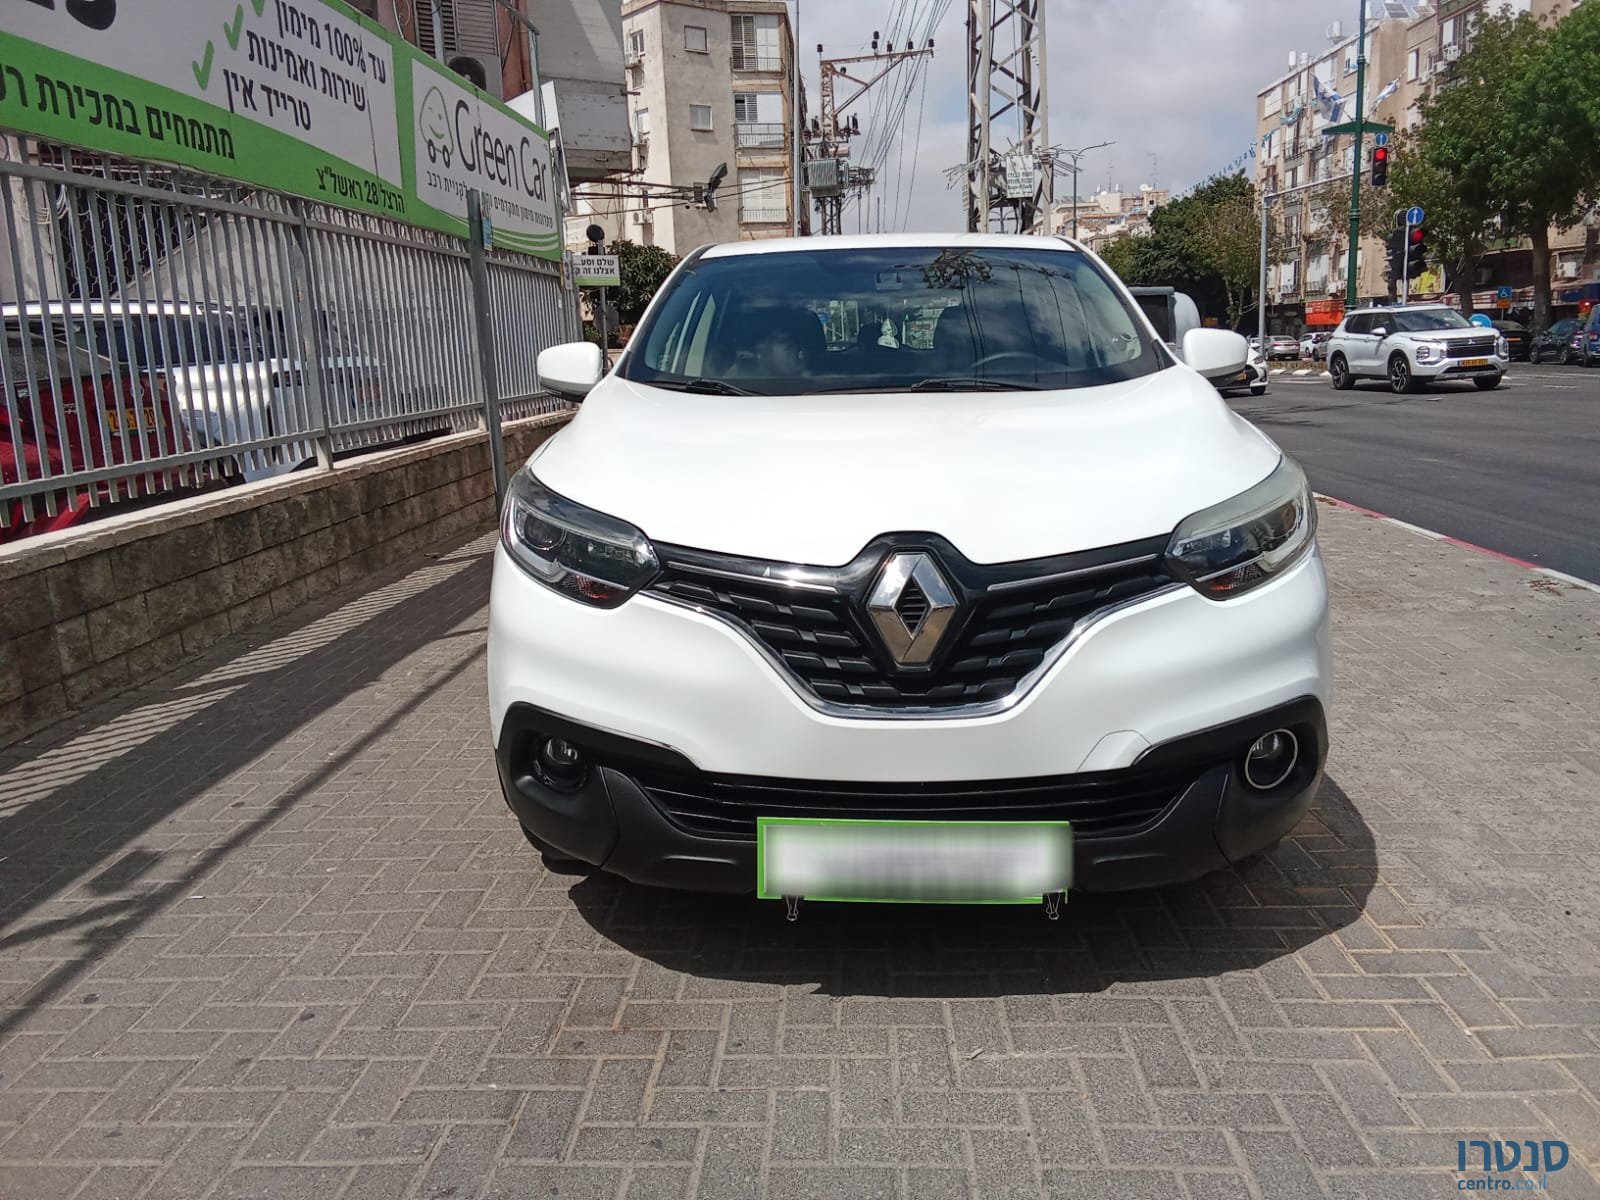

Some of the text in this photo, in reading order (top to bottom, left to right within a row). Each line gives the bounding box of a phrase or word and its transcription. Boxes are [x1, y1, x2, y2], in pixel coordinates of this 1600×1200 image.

[275, 0, 387, 84] עד 100% מימון
[246, 30, 366, 111] שירות ואמינות
[0, 64, 236, 159] מתמחים במכירת ר
[223, 69, 312, 131] טרייד אין
[455, 99, 547, 203] Green Car
[364, 180, 379, 205] 28
[427, 171, 442, 189] רכב
[380, 183, 405, 213] הרצל
[582, 267, 591, 275] זה
[593, 266, 615, 275] אצלנו
[597, 257, 614, 266] שלם
